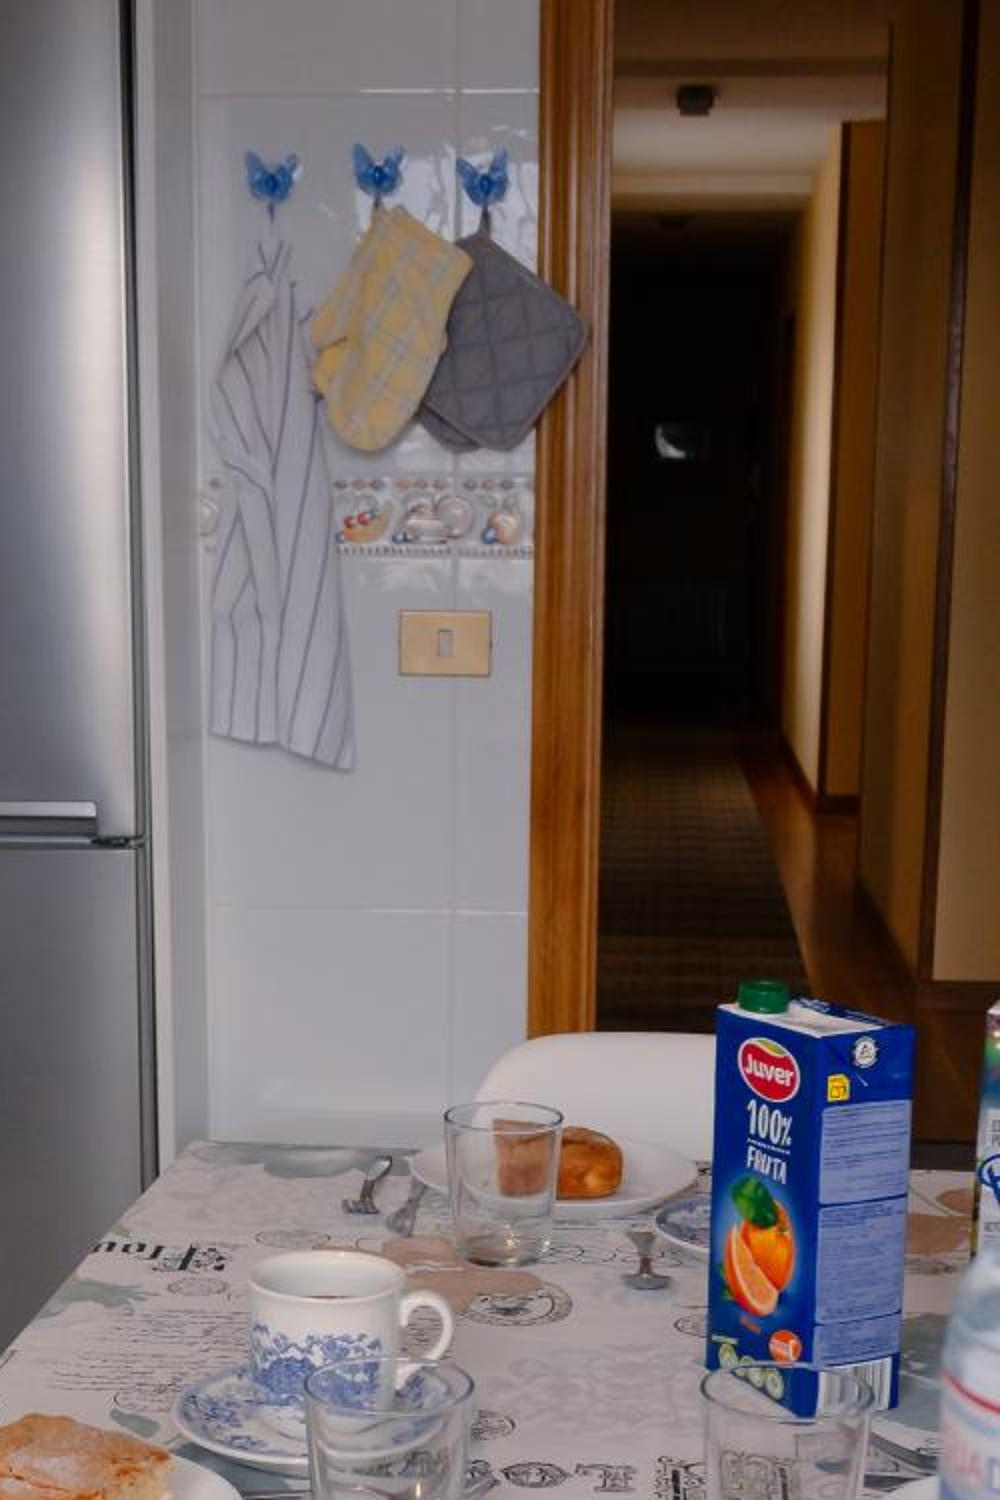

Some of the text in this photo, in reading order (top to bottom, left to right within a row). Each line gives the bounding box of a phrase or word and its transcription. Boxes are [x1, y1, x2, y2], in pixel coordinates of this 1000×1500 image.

[744, 1053, 794, 1087] Juver
[747, 1098, 793, 1146] 100%
[747, 1145, 788, 1185] FRUTA
